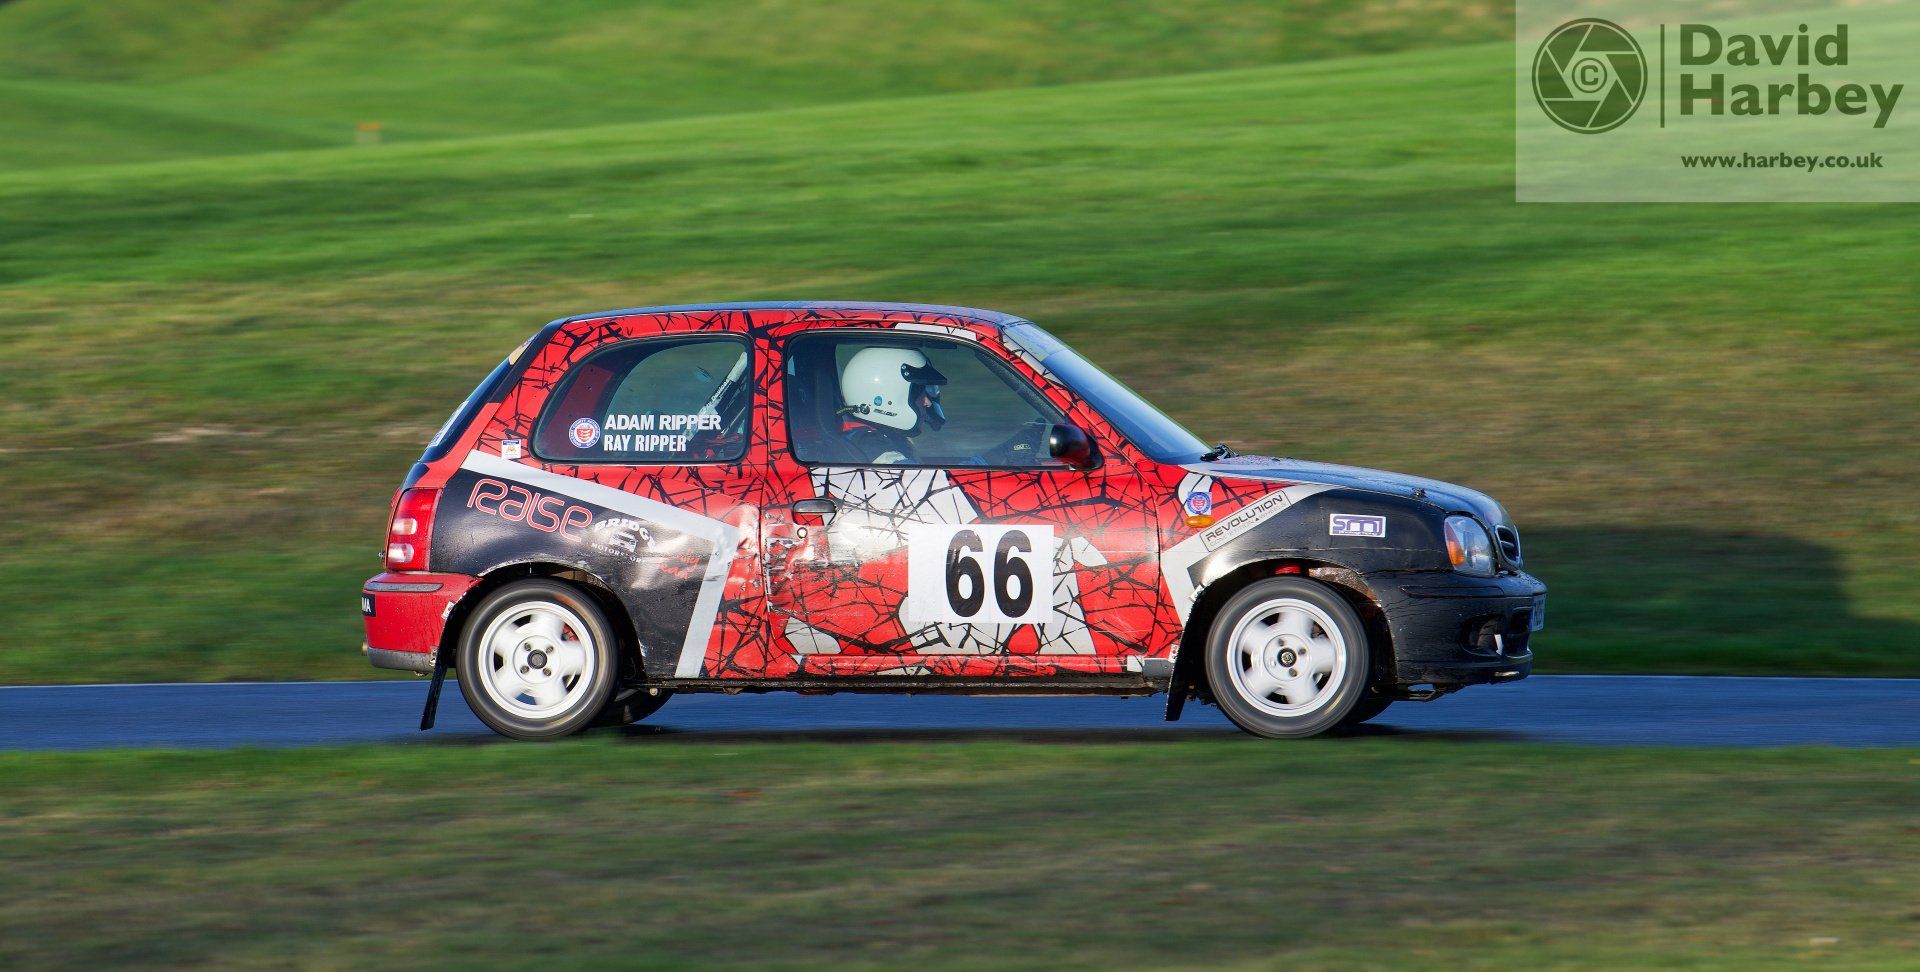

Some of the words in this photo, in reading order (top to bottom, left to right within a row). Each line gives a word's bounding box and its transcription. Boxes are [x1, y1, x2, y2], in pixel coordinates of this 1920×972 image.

[604, 414, 654, 431] ADAM
[658, 414, 722, 431] RIPPER
[603, 434, 631, 452] RAY
[634, 434, 687, 452] RIPPER
[1205, 494, 1283, 542] REVOLUTION
[945, 529, 1034, 618] 66
